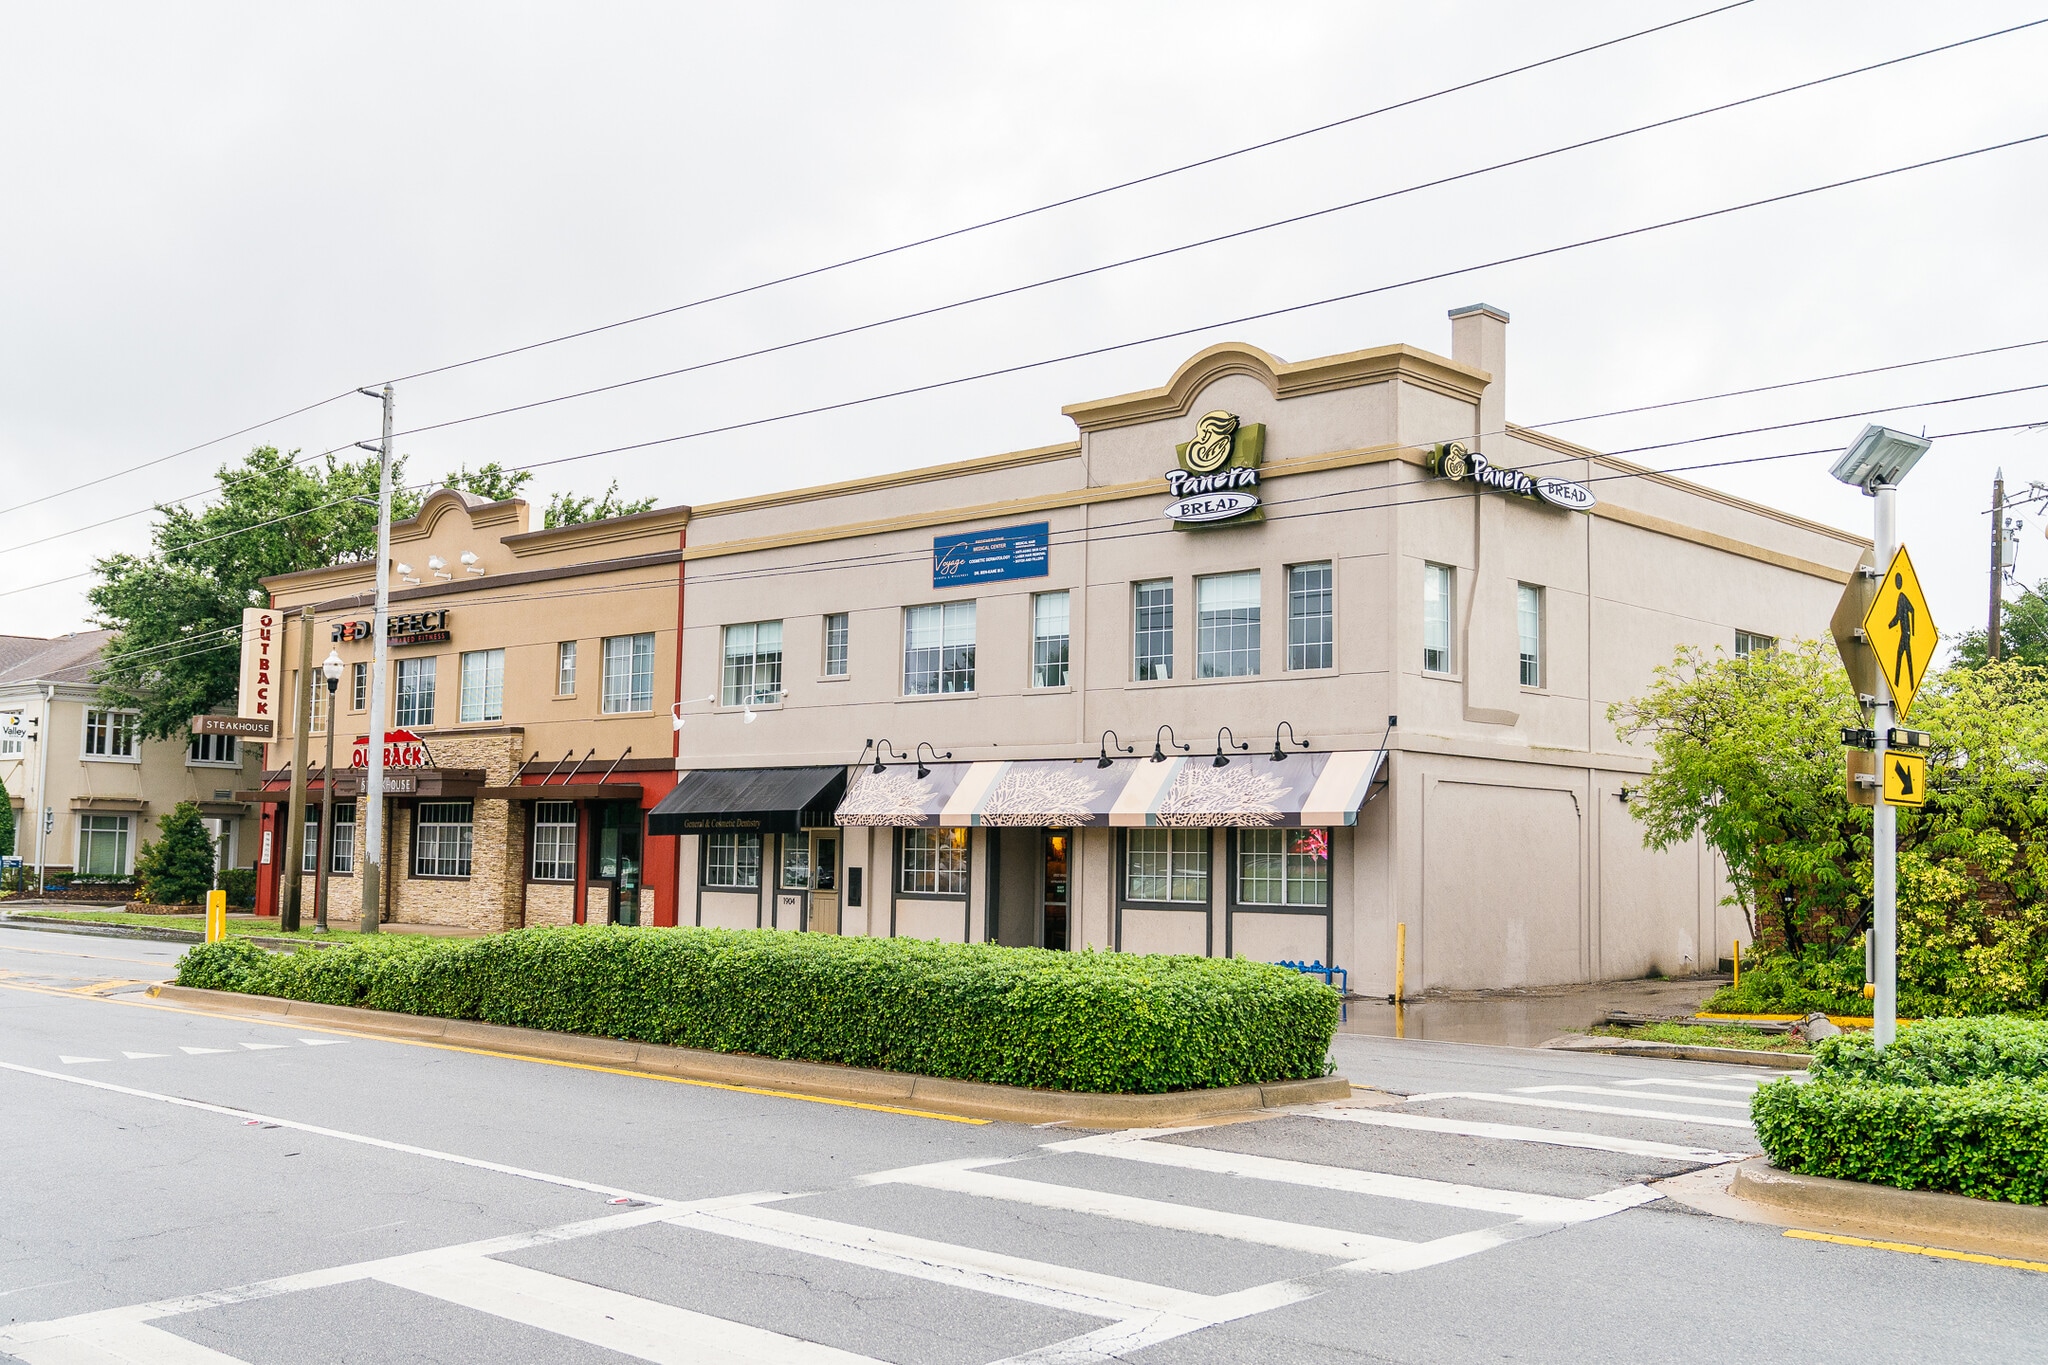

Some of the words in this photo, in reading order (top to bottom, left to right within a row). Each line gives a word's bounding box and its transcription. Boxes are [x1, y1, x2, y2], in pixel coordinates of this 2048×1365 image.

[1165, 467, 1257, 496] Panera
[1471, 453, 1533, 495] Panera
[1548, 481, 1587, 502] BREAD
[1180, 498, 1239, 516] BREAD
[934, 542, 966, 575] Voyage
[331, 620, 371, 643] RED
[373, 609, 450, 636] FFECT
[418, 632, 446, 641] FITNESS
[256, 614, 272, 714] OUTBACK
[3, 726, 26, 738] Valley
[206, 720, 270, 732] STEAKHOUSE
[352, 746, 422, 768] OUBACK
[705, 820, 710, 828] &
[711, 818, 735, 828] Cosmetic
[736, 818, 761, 829] Dentistry
[783, 897, 796, 905] 1904
